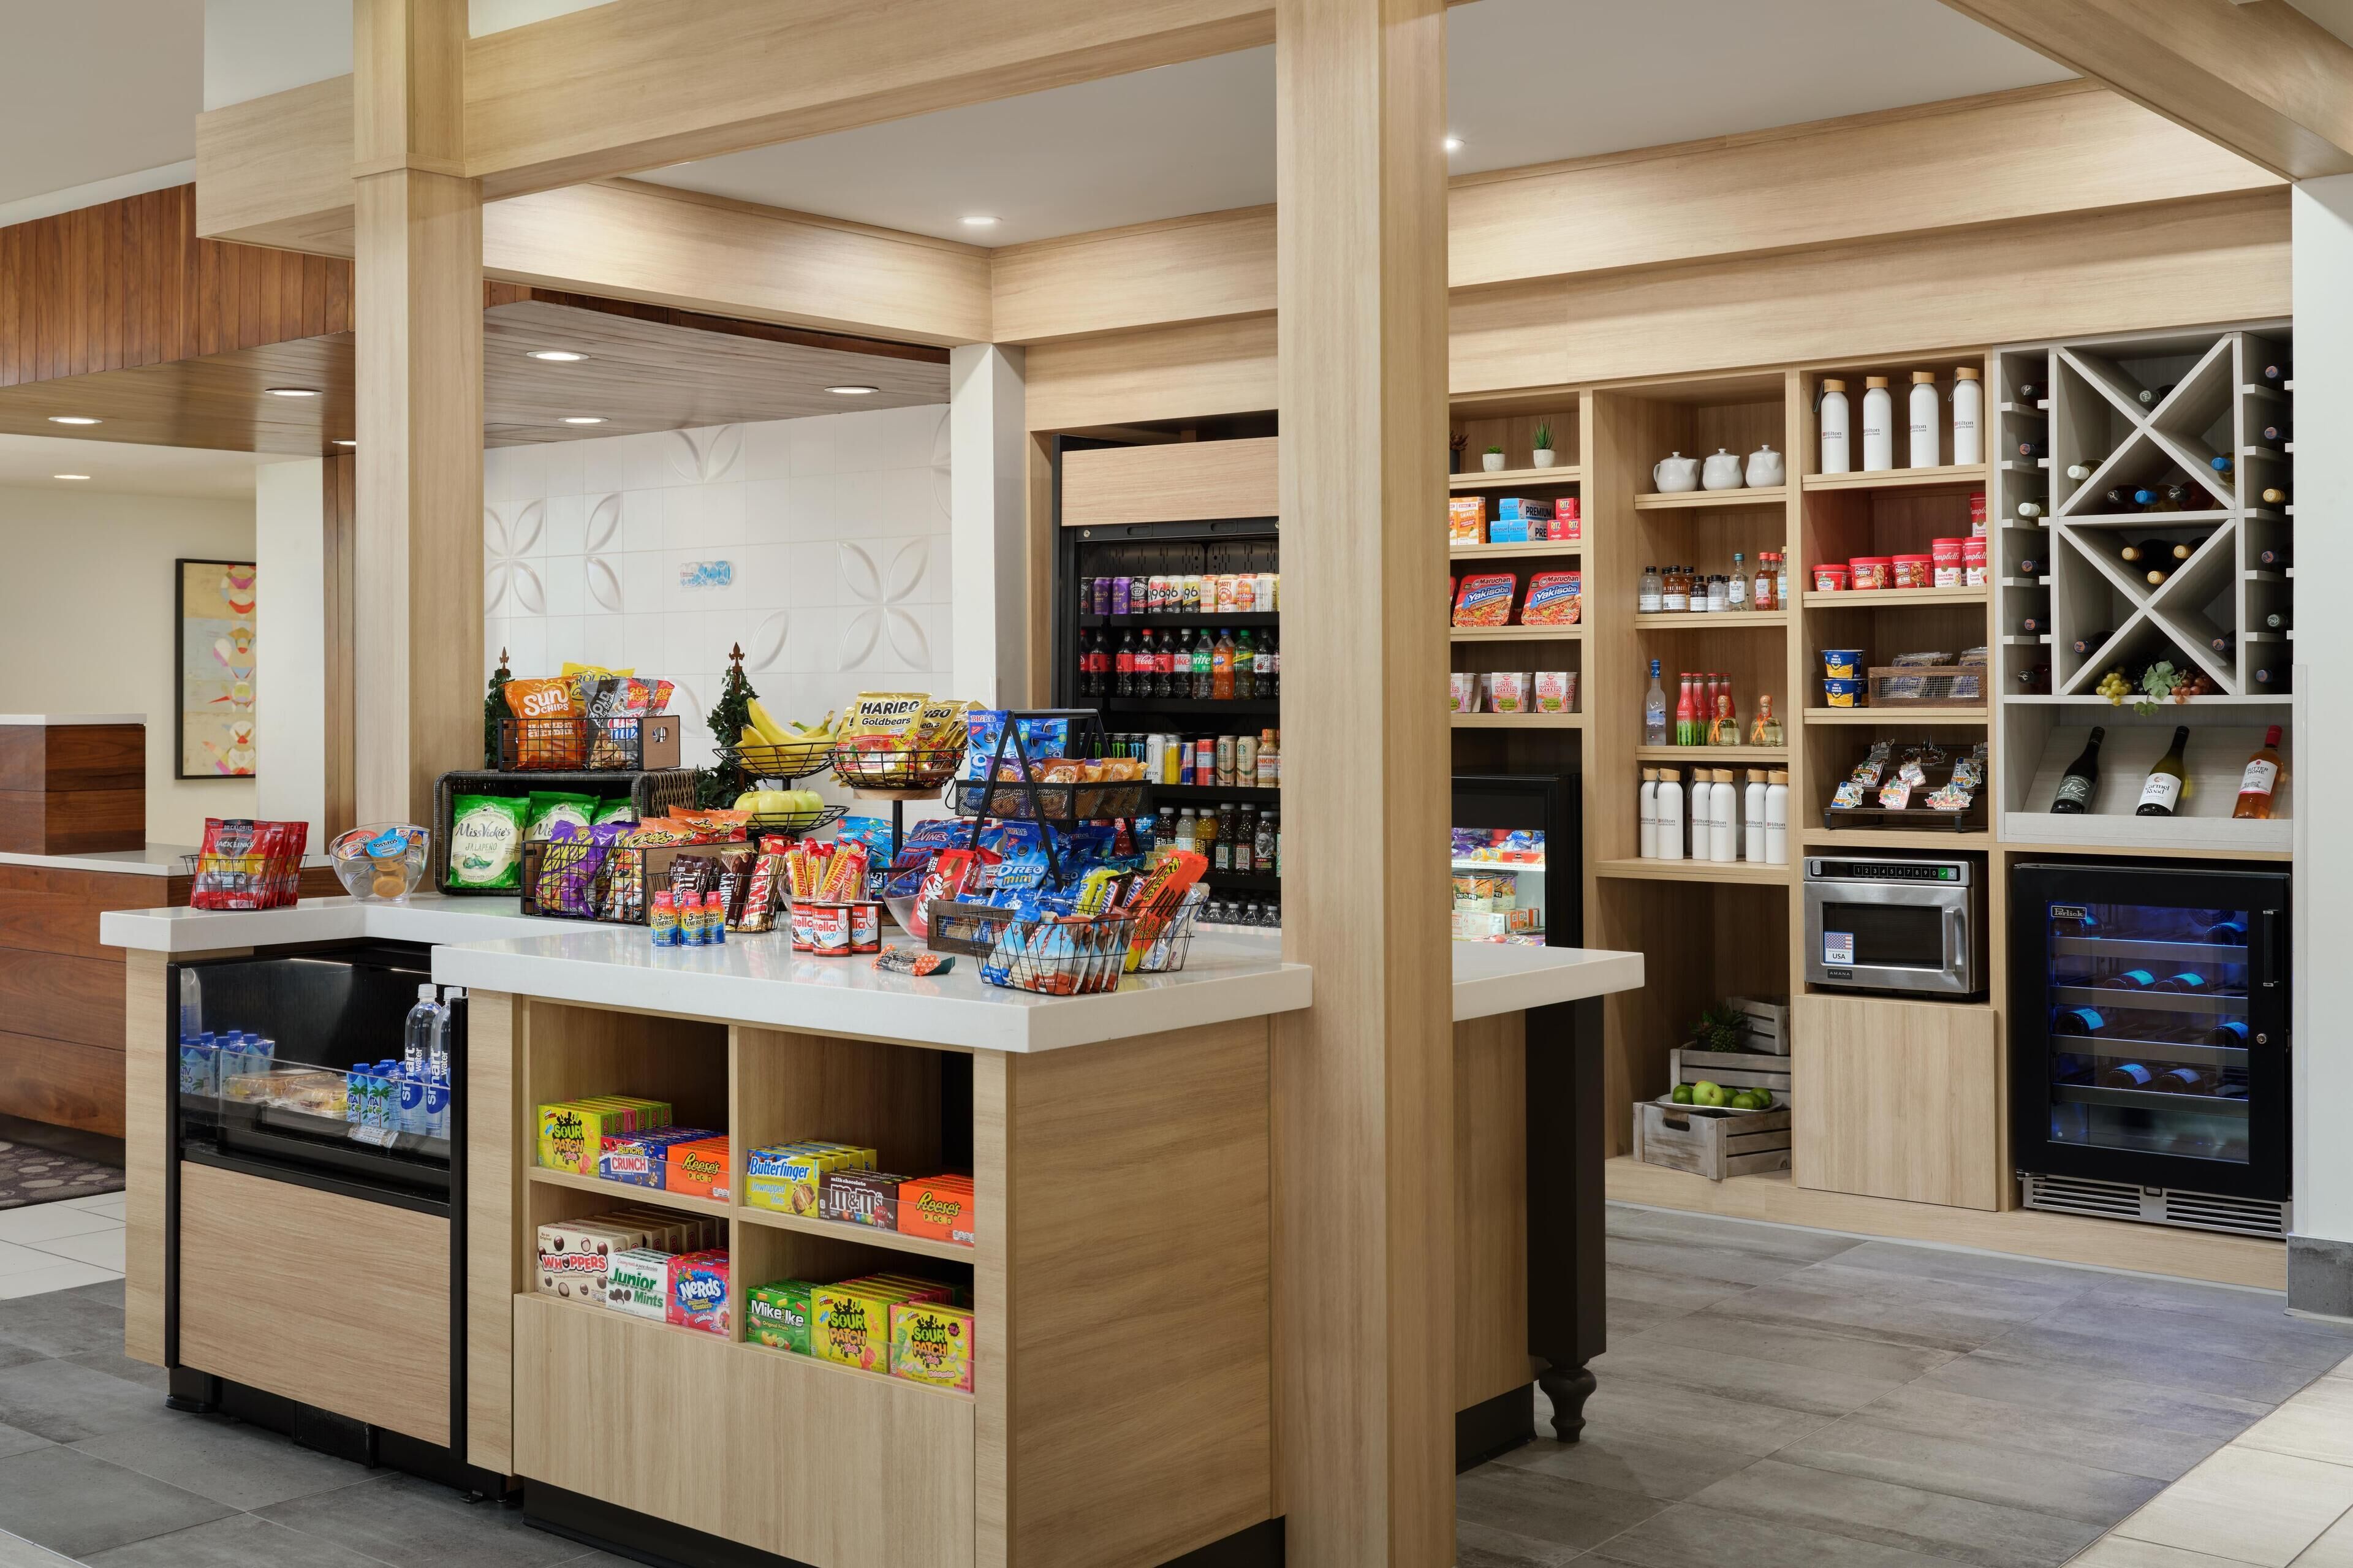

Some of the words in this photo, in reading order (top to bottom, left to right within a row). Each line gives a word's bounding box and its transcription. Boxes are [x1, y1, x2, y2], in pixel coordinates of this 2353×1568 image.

[1526, 506, 1552, 517] PREMIUM
[1468, 586, 1509, 603] Yakisoba
[1536, 585, 1577, 602] Yakisoba
[1175, 656, 1189, 665] oke
[523, 689, 569, 716] Sun
[540, 703, 570, 714] CHIPS
[860, 700, 920, 715] HARIBO
[862, 718, 911, 726] Goldbears
[920, 831, 949, 842] VINES
[926, 857, 934, 873] KING
[931, 857, 939, 872] SIZE
[996, 865, 1044, 877] OREO
[742, 855, 771, 917] TWIX
[1003, 874, 1033, 885] mini
[1142, 856, 1180, 903] Reese's
[2054, 908, 2083, 917] Perlick
[553, 1123, 582, 1138] SOUR
[553, 1138, 584, 1153] PATCH
[618, 1144, 644, 1156] Buncha
[612, 1156, 647, 1172] CRUNCH
[682, 1152, 721, 1175] Reese's
[750, 1157, 810, 1181] Butterfinger
[751, 1181, 786, 1194] Unwrapped
[771, 1195, 785, 1205] Minis
[916, 1191, 962, 1217] Reese's
[542, 1255, 607, 1271] WHOPPERS
[608, 1268, 657, 1290] Junior
[634, 1290, 664, 1308] Mints
[694, 1314, 714, 1324] rainbow
[751, 1300, 782, 1319] Mike
[784, 1309, 805, 1327] Ike
[830, 1311, 865, 1330] SOUR
[829, 1328, 866, 1346] PATCH
[914, 1325, 945, 1343] SOUR
[844, 1343, 859, 1354] Kids
[912, 1341, 948, 1357] PATCH
[925, 1355, 939, 1365] Kids
